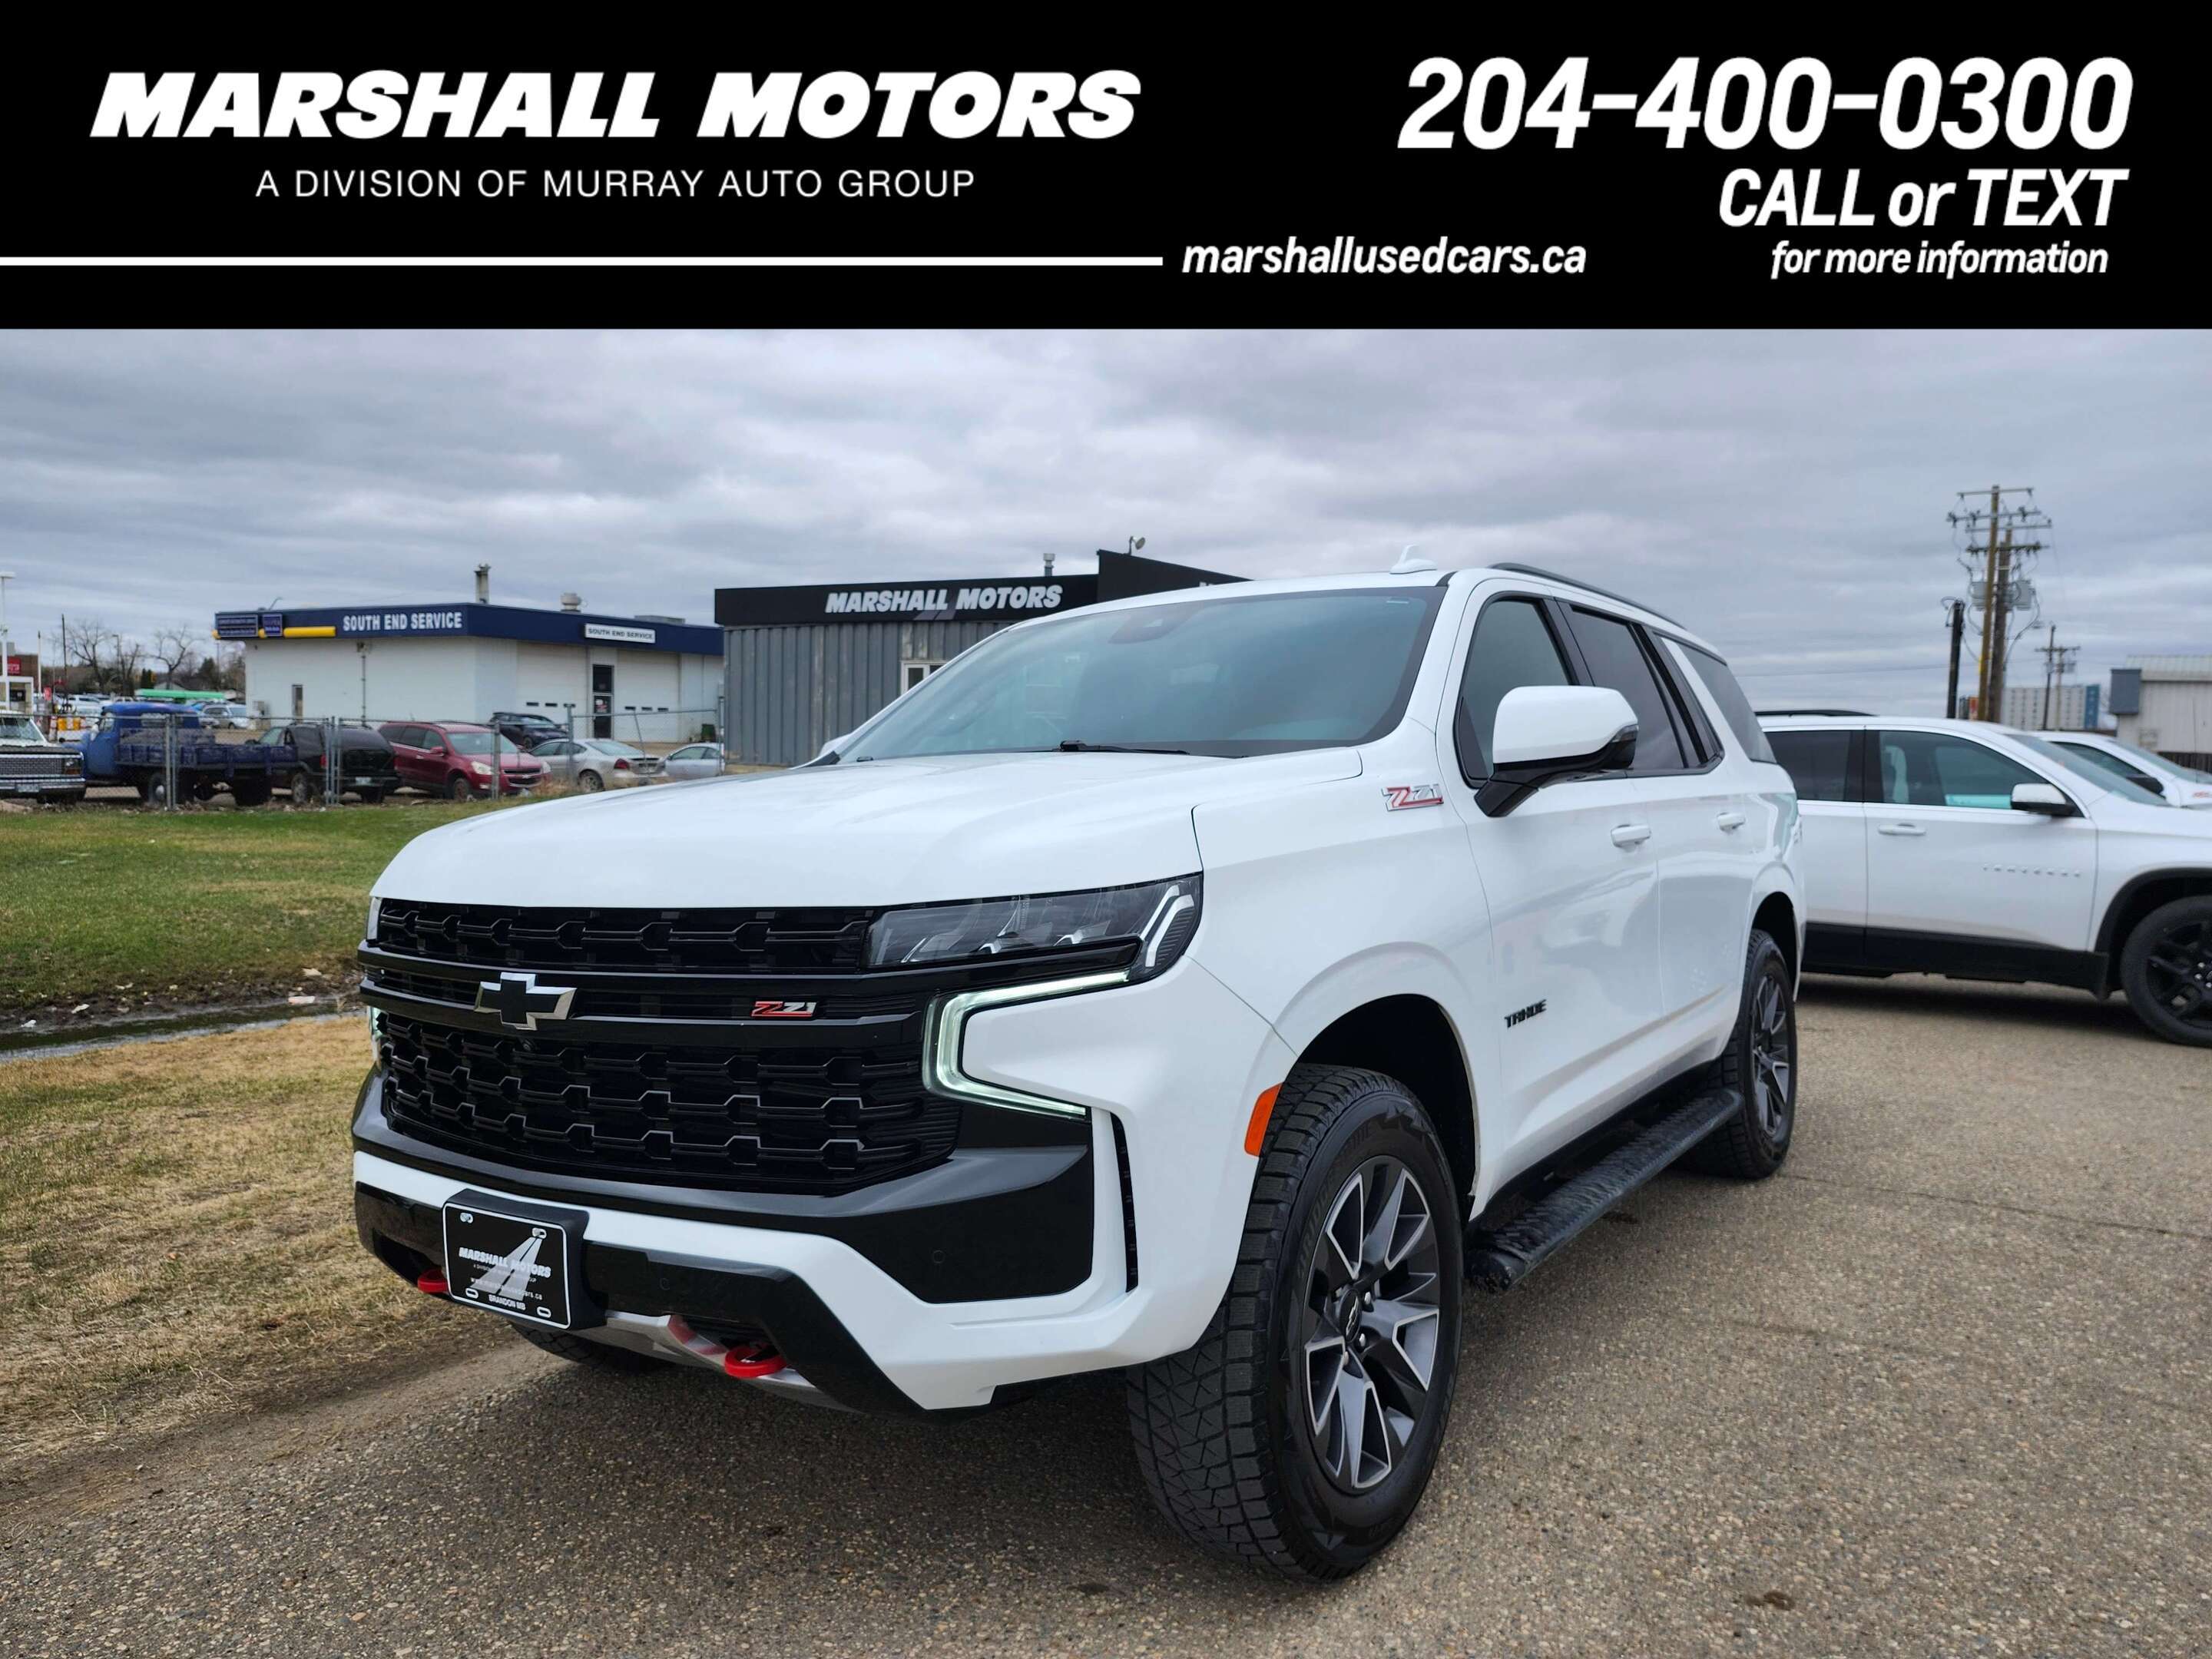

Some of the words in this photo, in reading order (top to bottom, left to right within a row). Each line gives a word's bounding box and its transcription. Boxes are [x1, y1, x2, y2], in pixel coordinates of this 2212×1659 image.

[825, 589, 949, 614] MARSHALL
[955, 585, 1063, 610] MOTORS
[343, 614, 381, 631] SOUTH
[384, 614, 408, 630] END
[411, 612, 462, 629] SERVICE
[1504, 998, 1547, 1028] TAHOE
[459, 1247, 508, 1267] MARSHALL
[510, 1259, 551, 1278] MOTORS
